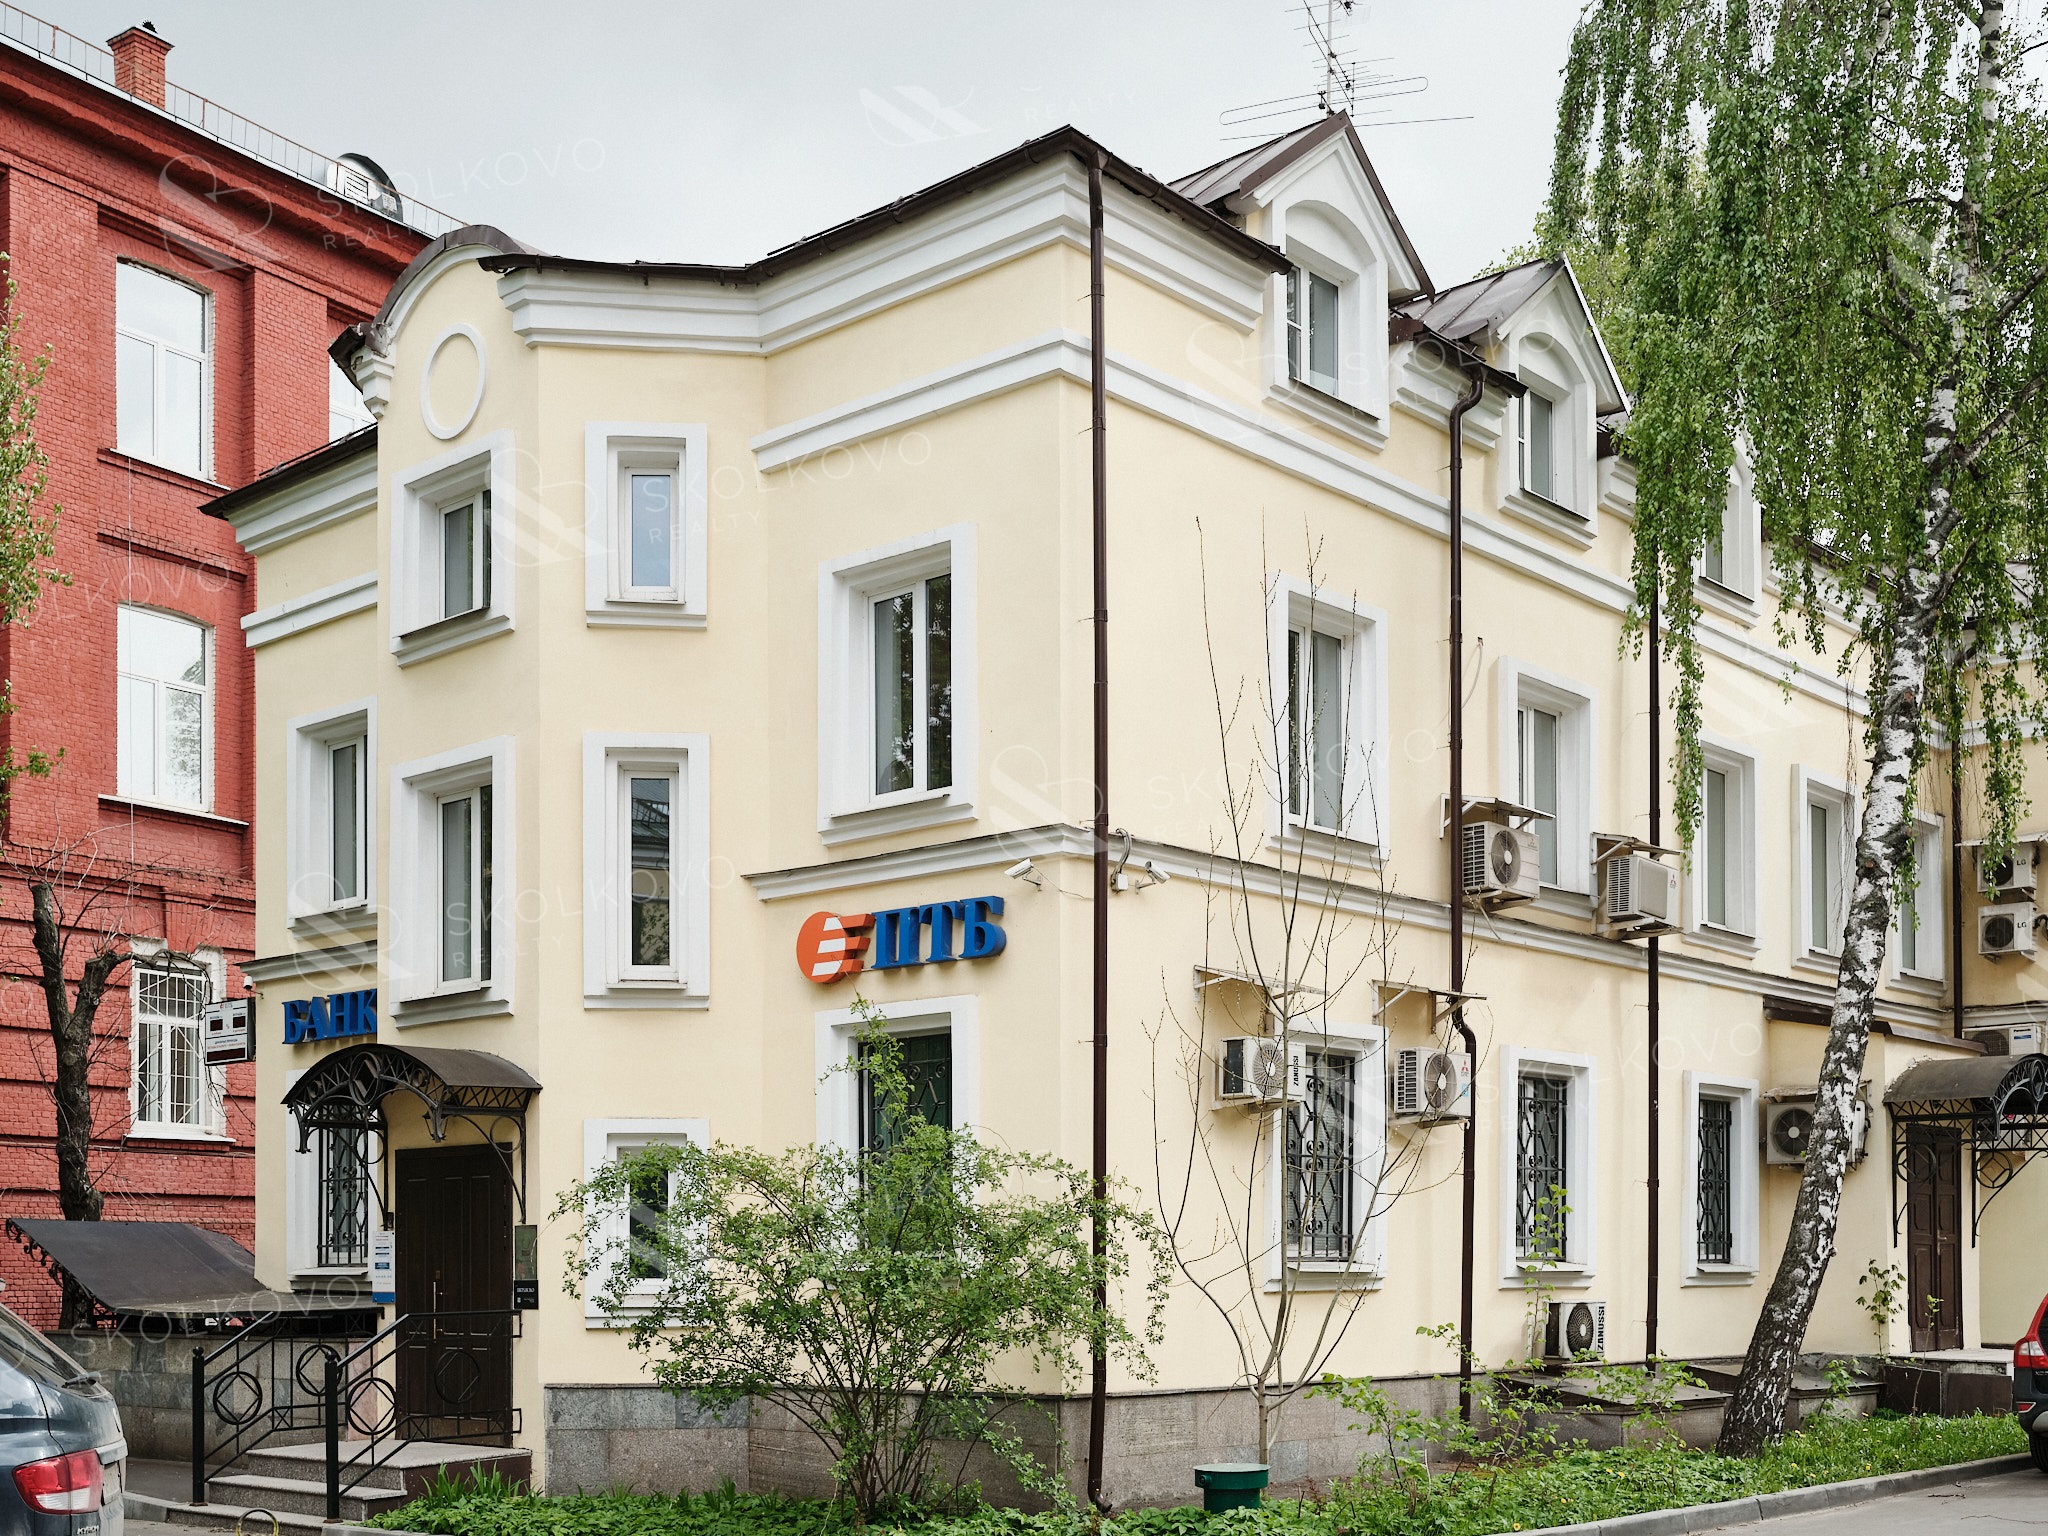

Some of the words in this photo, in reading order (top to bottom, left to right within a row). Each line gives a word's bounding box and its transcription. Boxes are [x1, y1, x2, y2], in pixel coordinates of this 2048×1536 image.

[871, 896, 1007, 969] ПТБ
[2017, 921, 2027, 929] LG
[281, 987, 378, 1044] БАНК
[1597, 1306, 1605, 1351] ZANUSSI
